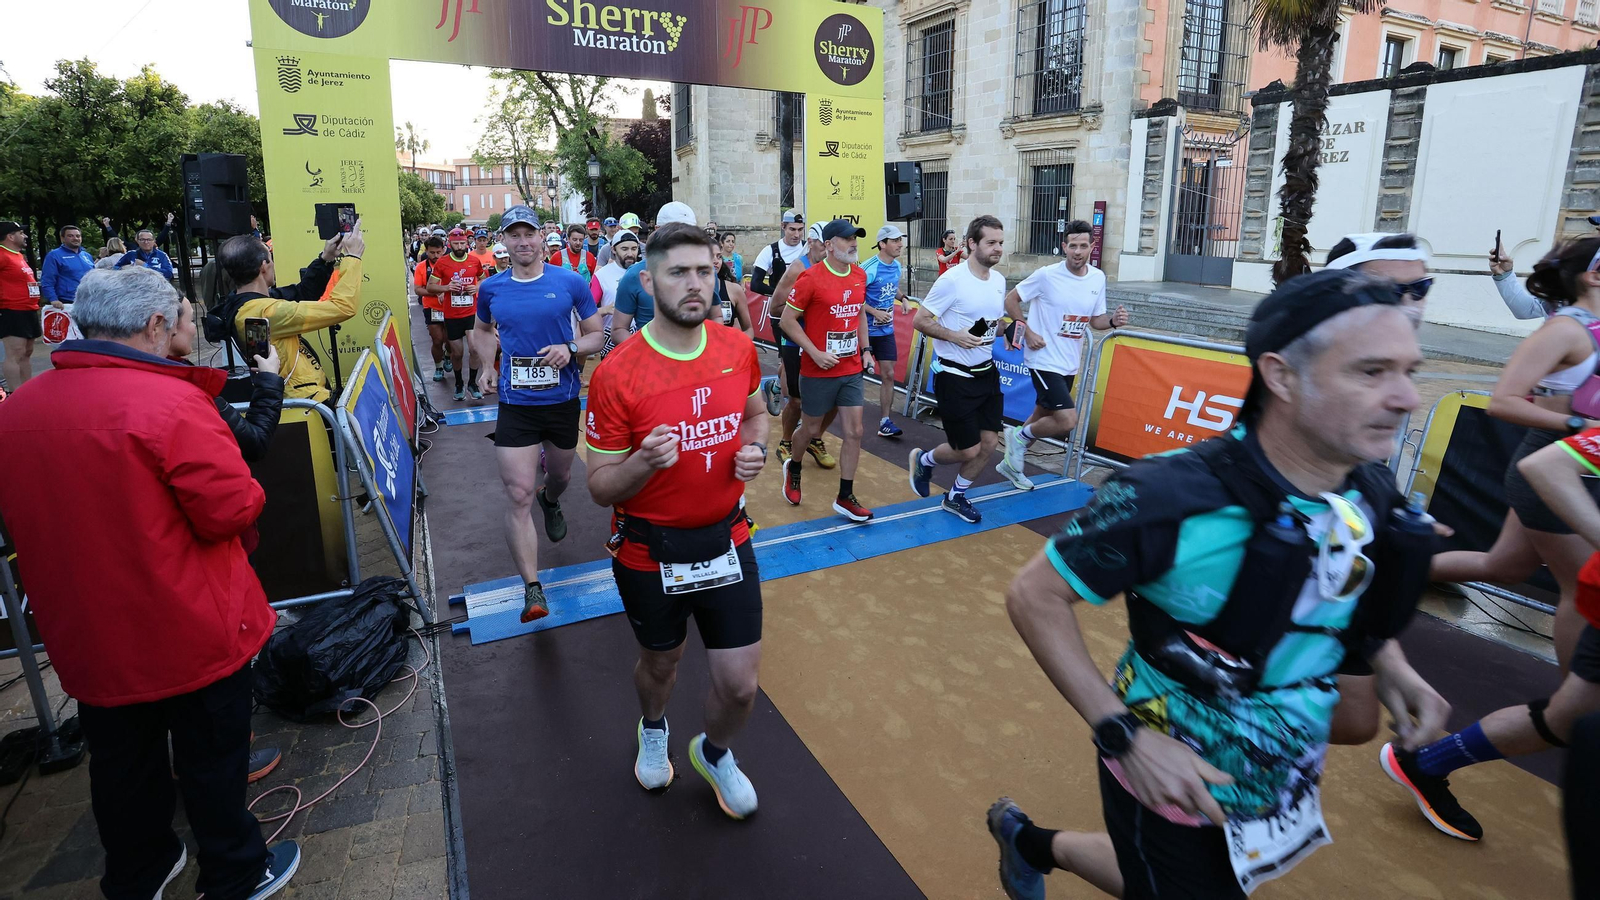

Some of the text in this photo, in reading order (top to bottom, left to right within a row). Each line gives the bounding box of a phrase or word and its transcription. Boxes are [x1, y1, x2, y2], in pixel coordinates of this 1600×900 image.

[547, 0, 687, 52] Sherry
[573, 28, 667, 55] Maratón
[819, 40, 870, 64] Sherry
[828, 54, 862, 66] Maratón
[307, 69, 371, 80] Ayuntamiento
[321, 78, 344, 87] Jerez
[836, 108, 873, 117] Ayuntamiento
[321, 114, 374, 126] Diputación
[323, 128, 366, 138] de Cádiz
[1320, 121, 1366, 136] AZAR
[841, 141, 873, 151] Diputación
[841, 151, 867, 159] de Cádiz
[1320, 151, 1349, 164] REZ
[365, 302, 389, 316] VALDESPIN
[830, 303, 861, 315] Sherry
[1068, 322, 1085, 331] 1144
[837, 340, 852, 349] 170
[525, 367, 546, 379] 185
[1163, 385, 1245, 432] HS
[1144, 423, 1194, 443] WE ARE
[681, 431, 733, 452] Maratón
[692, 570, 719, 579] VILLALBA
